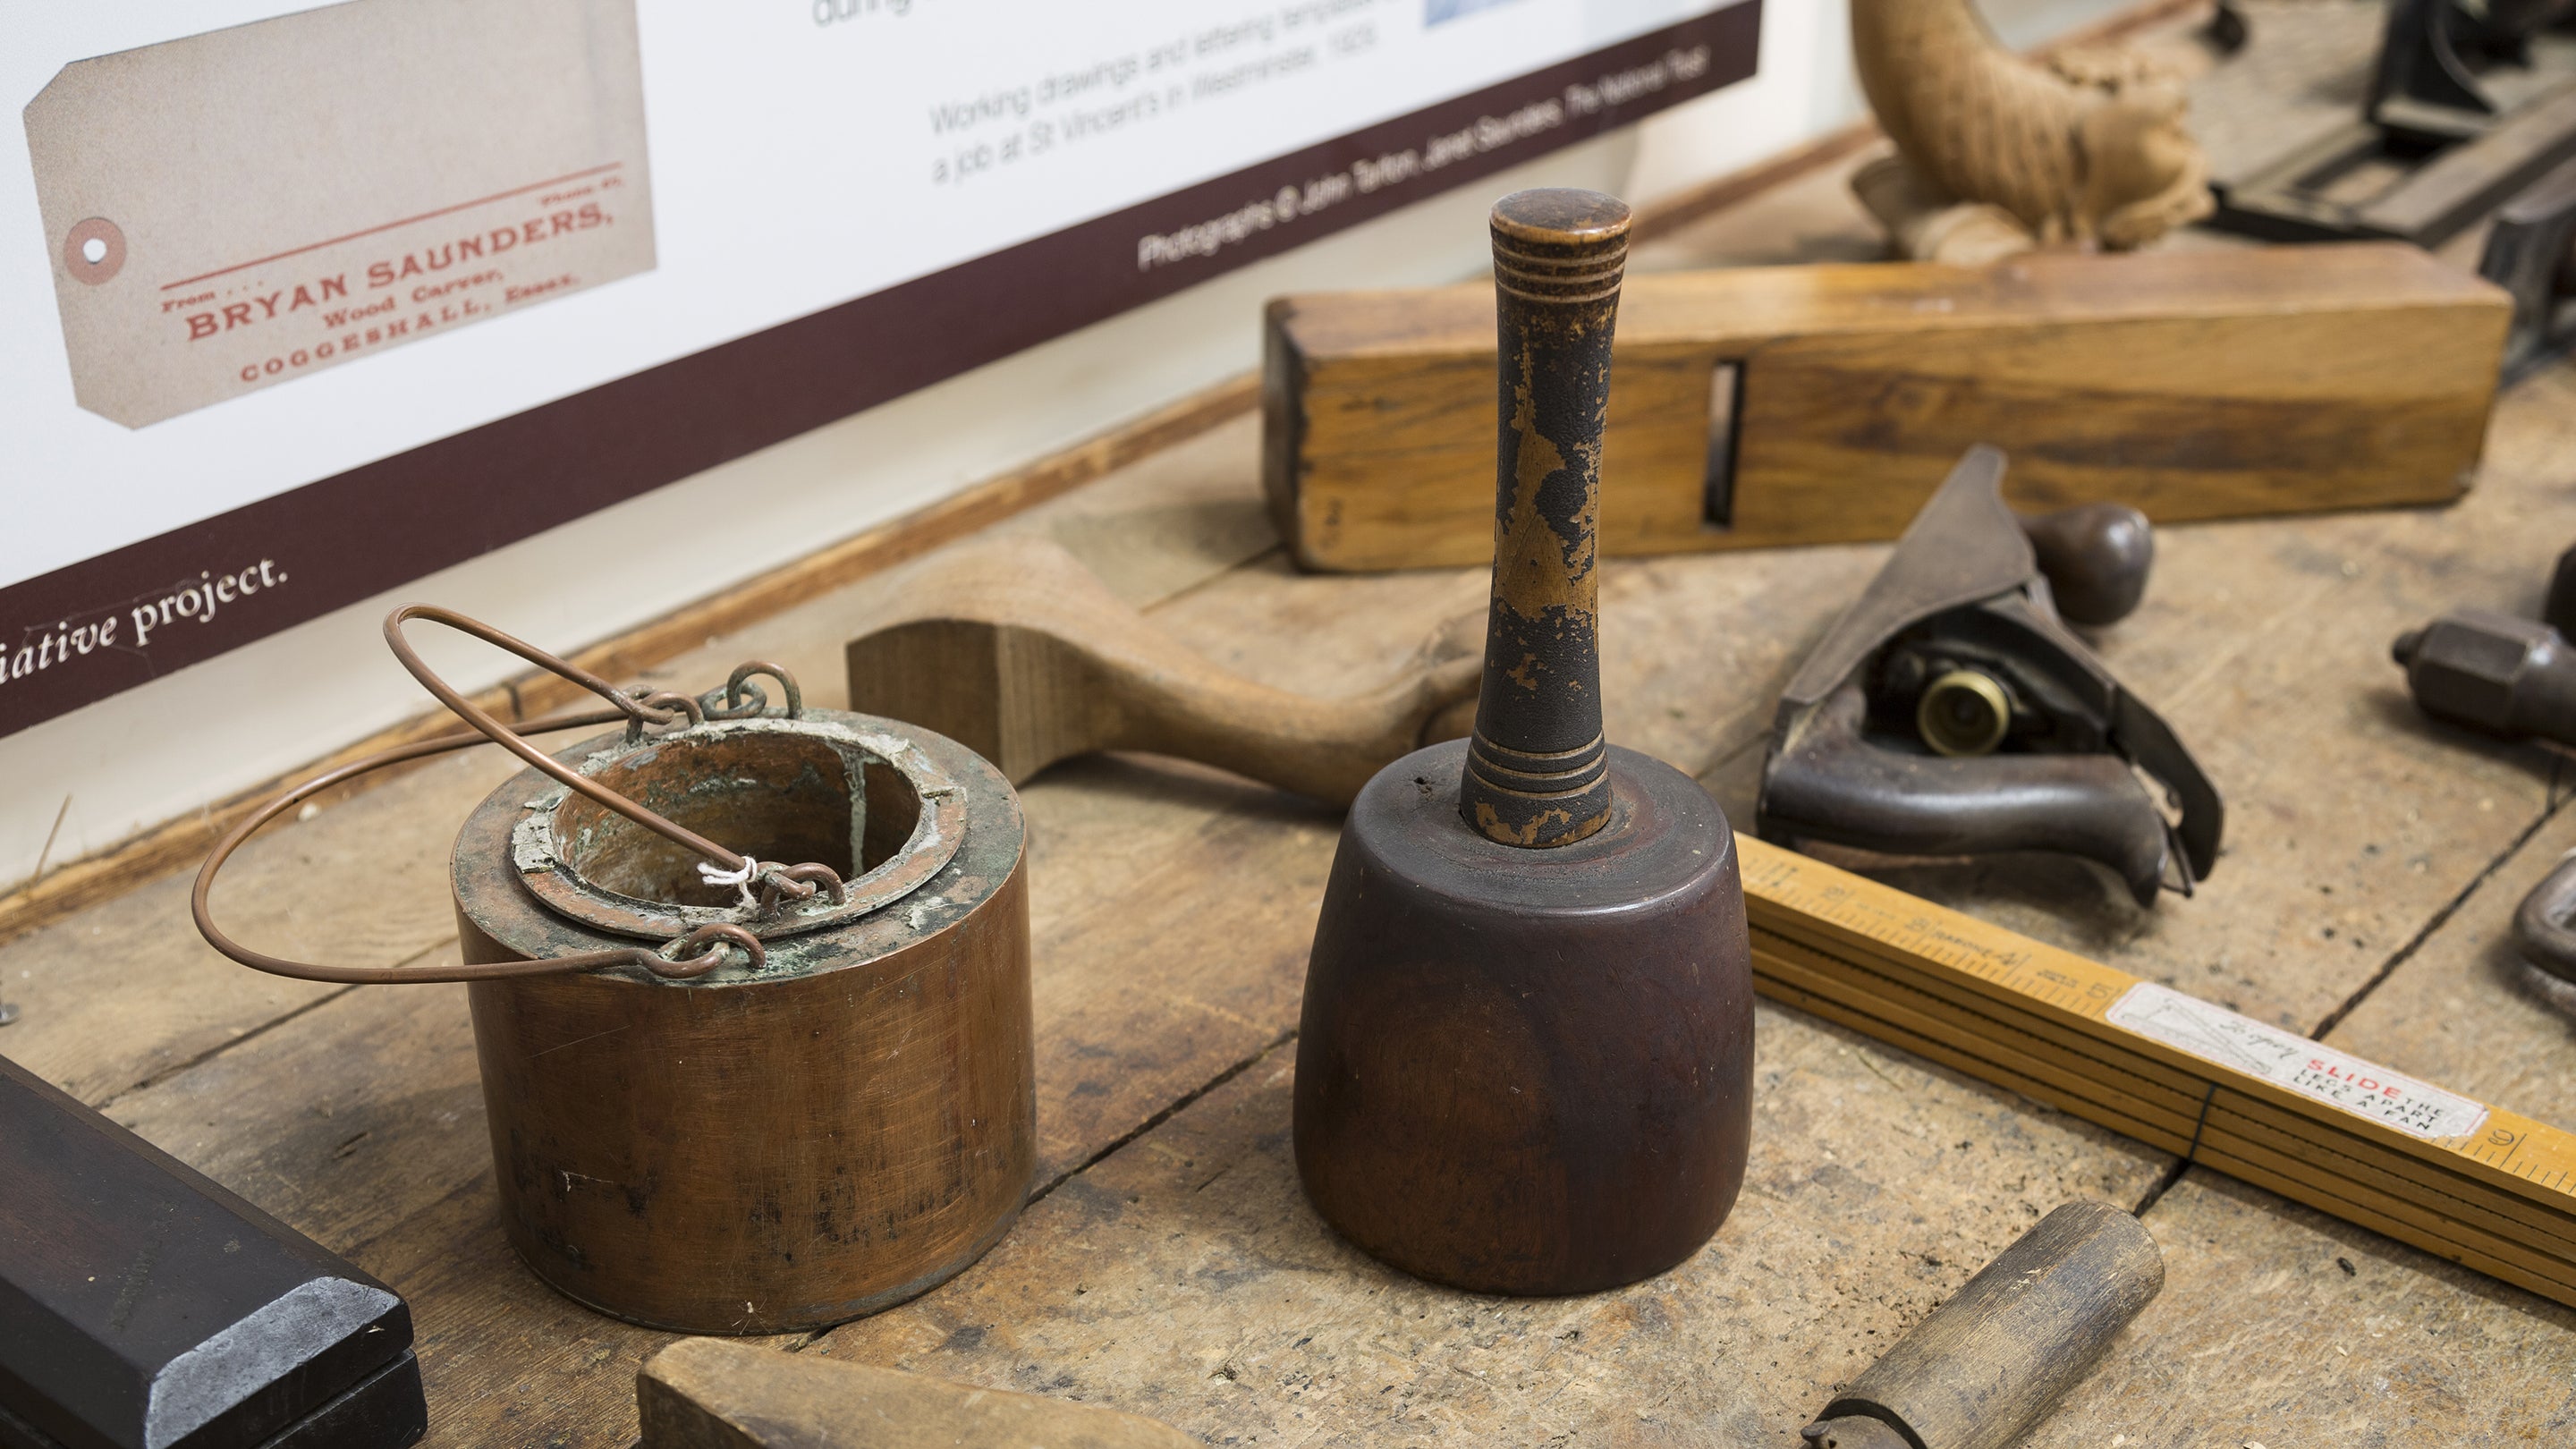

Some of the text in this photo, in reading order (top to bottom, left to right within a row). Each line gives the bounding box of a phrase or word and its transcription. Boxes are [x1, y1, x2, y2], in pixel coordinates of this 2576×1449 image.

[928, 85, 1032, 136] Working
[1035, 54, 1139, 105] drawings
[1145, 37, 1188, 73] and
[931, 157, 950, 186] a
[953, 140, 995, 186] job
[999, 131, 1023, 165] at
[1028, 119, 1055, 156] St
[1138, 199, 1275, 272] Photographs
[186, 202, 614, 342] BRYAN SAUNDERS,
[323, 269, 504, 328] Wood Carver,
[131, 558, 288, 648] project.
[2085, 981, 2114, 1000] 5
[2292, 1076, 2431, 1131] LIKE A FAN
[2300, 1069, 2438, 1123] LEGS APART
[2307, 1059, 2445, 1117] SLIDE THE
